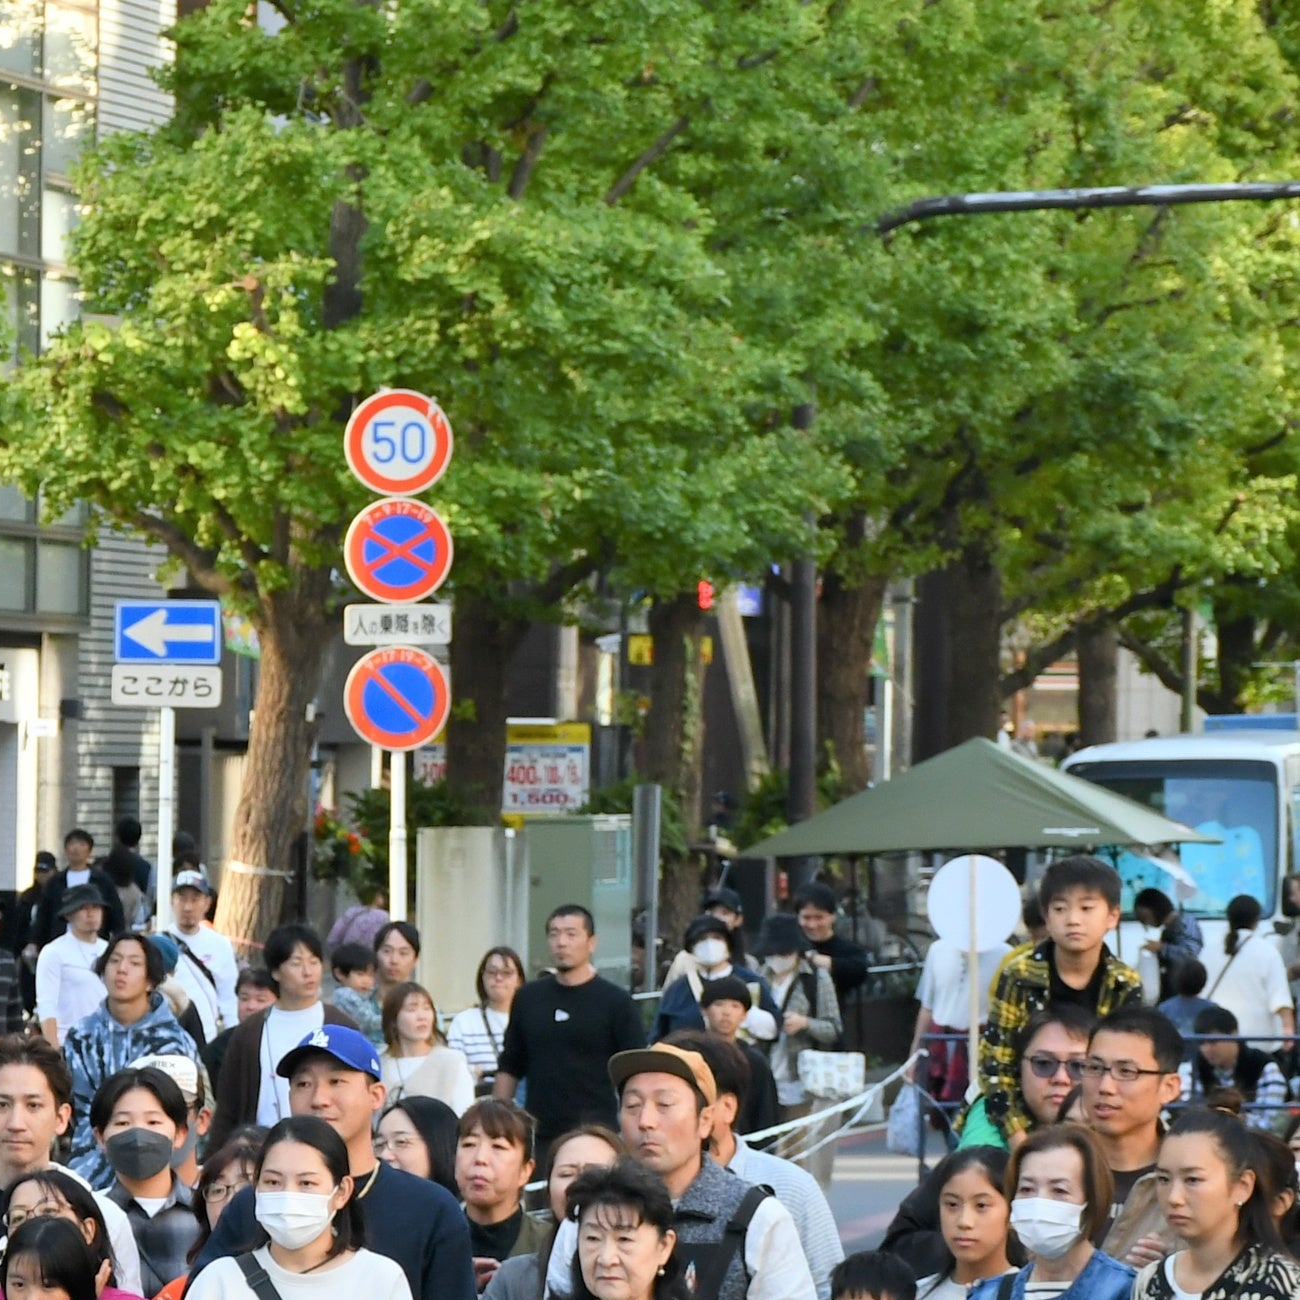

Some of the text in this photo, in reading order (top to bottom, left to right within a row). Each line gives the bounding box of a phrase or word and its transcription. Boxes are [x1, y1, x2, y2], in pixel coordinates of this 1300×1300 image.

[372, 421, 426, 464] 50
[352, 612, 448, 636] 人の乗降を除く
[120, 675, 212, 698] ここから
